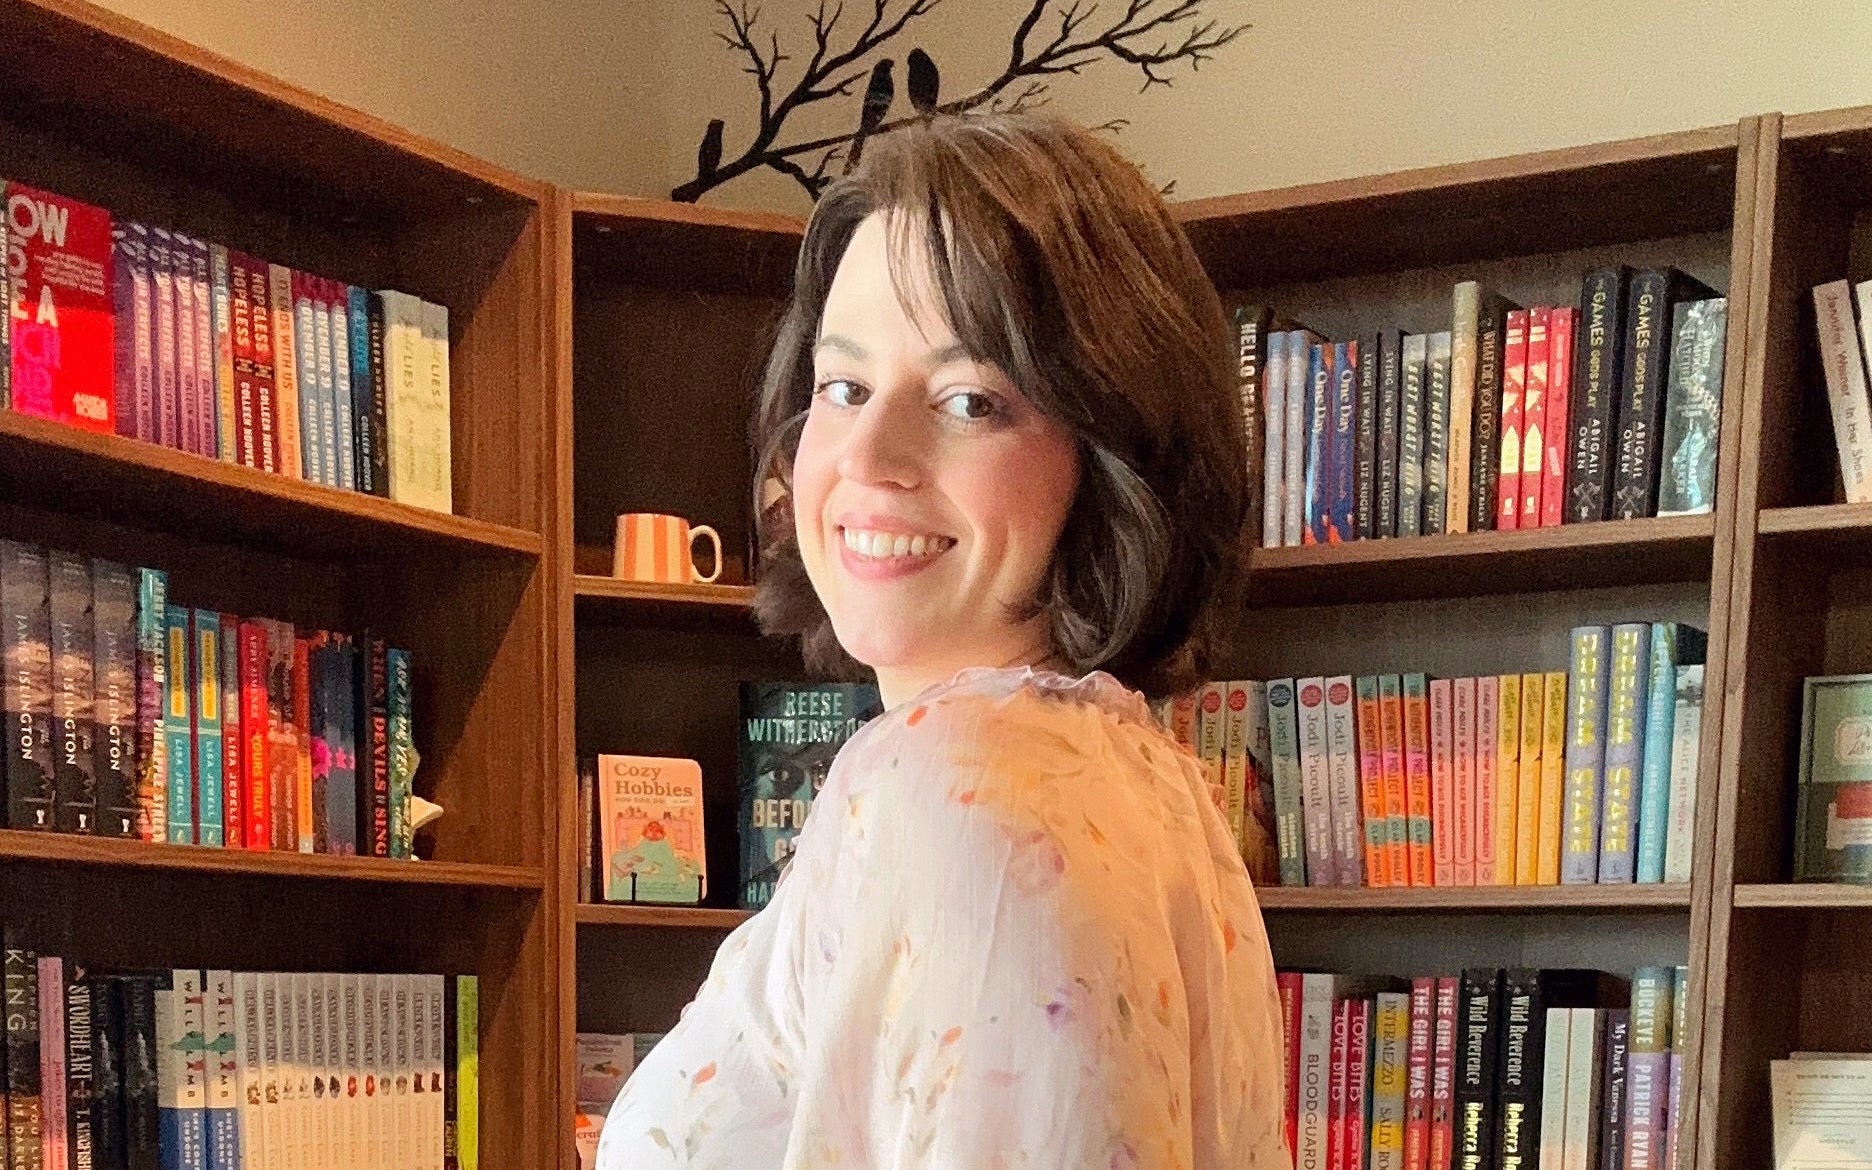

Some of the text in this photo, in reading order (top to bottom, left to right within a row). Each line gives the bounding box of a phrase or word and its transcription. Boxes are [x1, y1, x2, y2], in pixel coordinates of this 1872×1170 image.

[8, 194, 68, 247] OW
[233, 265, 250, 347] HOPELESS
[252, 272, 269, 352] HOPELESS
[1589, 291, 1607, 347] GAMES
[1634, 293, 1654, 349] GAMES
[280, 335, 293, 368] WITH
[1240, 323, 1257, 378] HELLO
[1362, 353, 1372, 391] LYING
[283, 372, 294, 389] US
[1338, 369, 1353, 434] One Day
[1432, 361, 1444, 399] BEST
[1586, 379, 1599, 408] PLAY
[1361, 406, 1371, 436] WAIT
[1403, 364, 1419, 497] BEST WORST THING
[1431, 402, 1442, 450] WORST
[1587, 418, 1602, 475] ABIGAIL
[1360, 459, 1369, 482] LIZ
[1576, 426, 1588, 470] OWEN
[1620, 429, 1633, 474] OWEN
[1631, 421, 1646, 479] ABIGAIL
[1358, 484, 1368, 528] NUGENT
[15, 613, 34, 761] JAMES ISLINGTON
[784, 692, 844, 717] REESE
[62, 675, 77, 766] ISLINGTON
[108, 683, 121, 771] ISLINGTON
[747, 718, 868, 745] WITHERSPO
[1207, 716, 1217, 754] Jodi
[152, 718, 166, 787] PINEAPPLE
[175, 738, 184, 817] LISA JEWELL
[251, 733, 264, 818] YOURS TRULY
[374, 716, 387, 793] DEVILS
[614, 762, 663, 781] Cozy
[1229, 715, 1242, 810] Jodi Picoult
[1306, 713, 1322, 808] Jodi Picoult
[1333, 713, 1349, 807] Jodi Picoult
[206, 740, 216, 818] LISA JEWELL
[227, 736, 238, 823] LISA JEWELL
[615, 780, 694, 798] Hobbies
[374, 806, 387, 857] SING
[752, 799, 815, 829] BEFO
[5, 948, 27, 1032] KING
[1413, 986, 1430, 1016] THE
[1437, 985, 1453, 1016] THE
[1467, 995, 1489, 1024] Wild
[1509, 995, 1530, 1024] Wild
[68, 984, 93, 1082] SWORDHEART
[1333, 1015, 1347, 1056] LOVE
[1350, 1015, 1367, 1057] LOVE
[1381, 1000, 1397, 1086] INTERMEZZO
[1411, 1018, 1429, 1053] GIRL
[1435, 1018, 1452, 1054] GIRL
[1466, 1025, 1487, 1086] Reverence
[1506, 1025, 1528, 1087] Reverence
[1613, 1022, 1627, 1040] My
[1409, 1063, 1426, 1100] WAS
[1433, 1063, 1449, 1100] WAS
[1612, 1044, 1626, 1076] Dark
[1631, 978, 1656, 1169] BUCKEYE PATRICK RYAN
[30, 1103, 40, 1136] YOU
[1304, 1053, 1320, 1170] BLOODGUARD
[1379, 1106, 1392, 1148] SALLY
[1463, 1102, 1484, 1153] Rebecca
[1503, 1102, 1525, 1153] Rebecca
